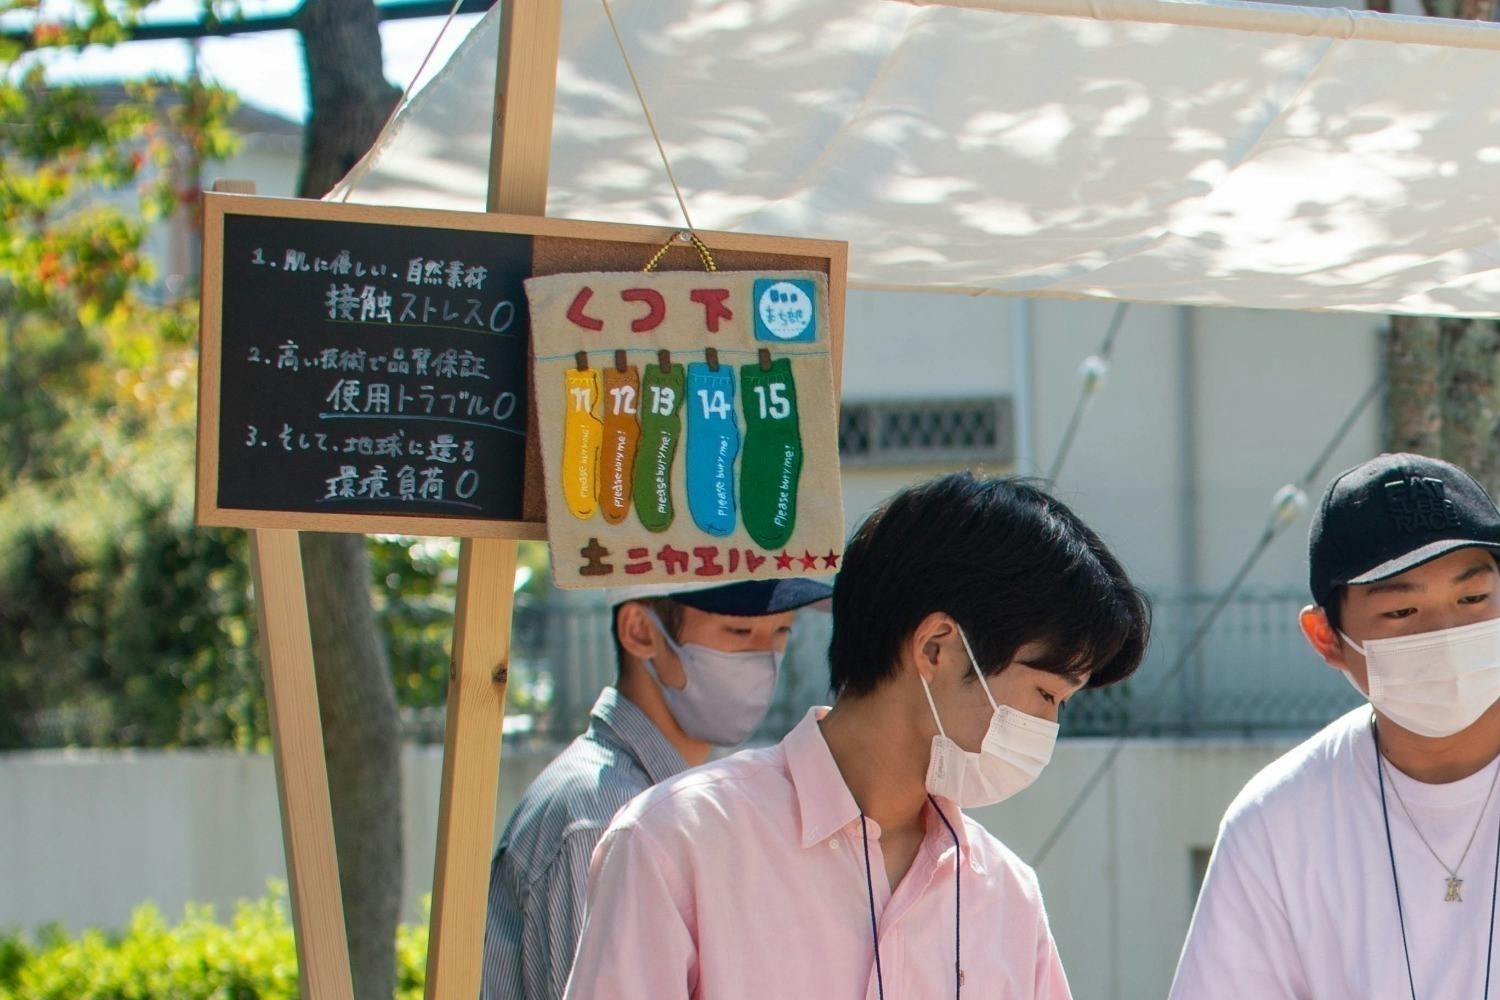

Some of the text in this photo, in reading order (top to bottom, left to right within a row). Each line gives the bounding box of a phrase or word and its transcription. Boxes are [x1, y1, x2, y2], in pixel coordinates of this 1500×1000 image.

[566, 286, 733, 333] くつ下
[570, 387, 592, 413] 11
[609, 385, 637, 416] 12
[650, 386, 676, 417] 13
[698, 389, 731, 420] 14
[754, 383, 791, 420] 15
